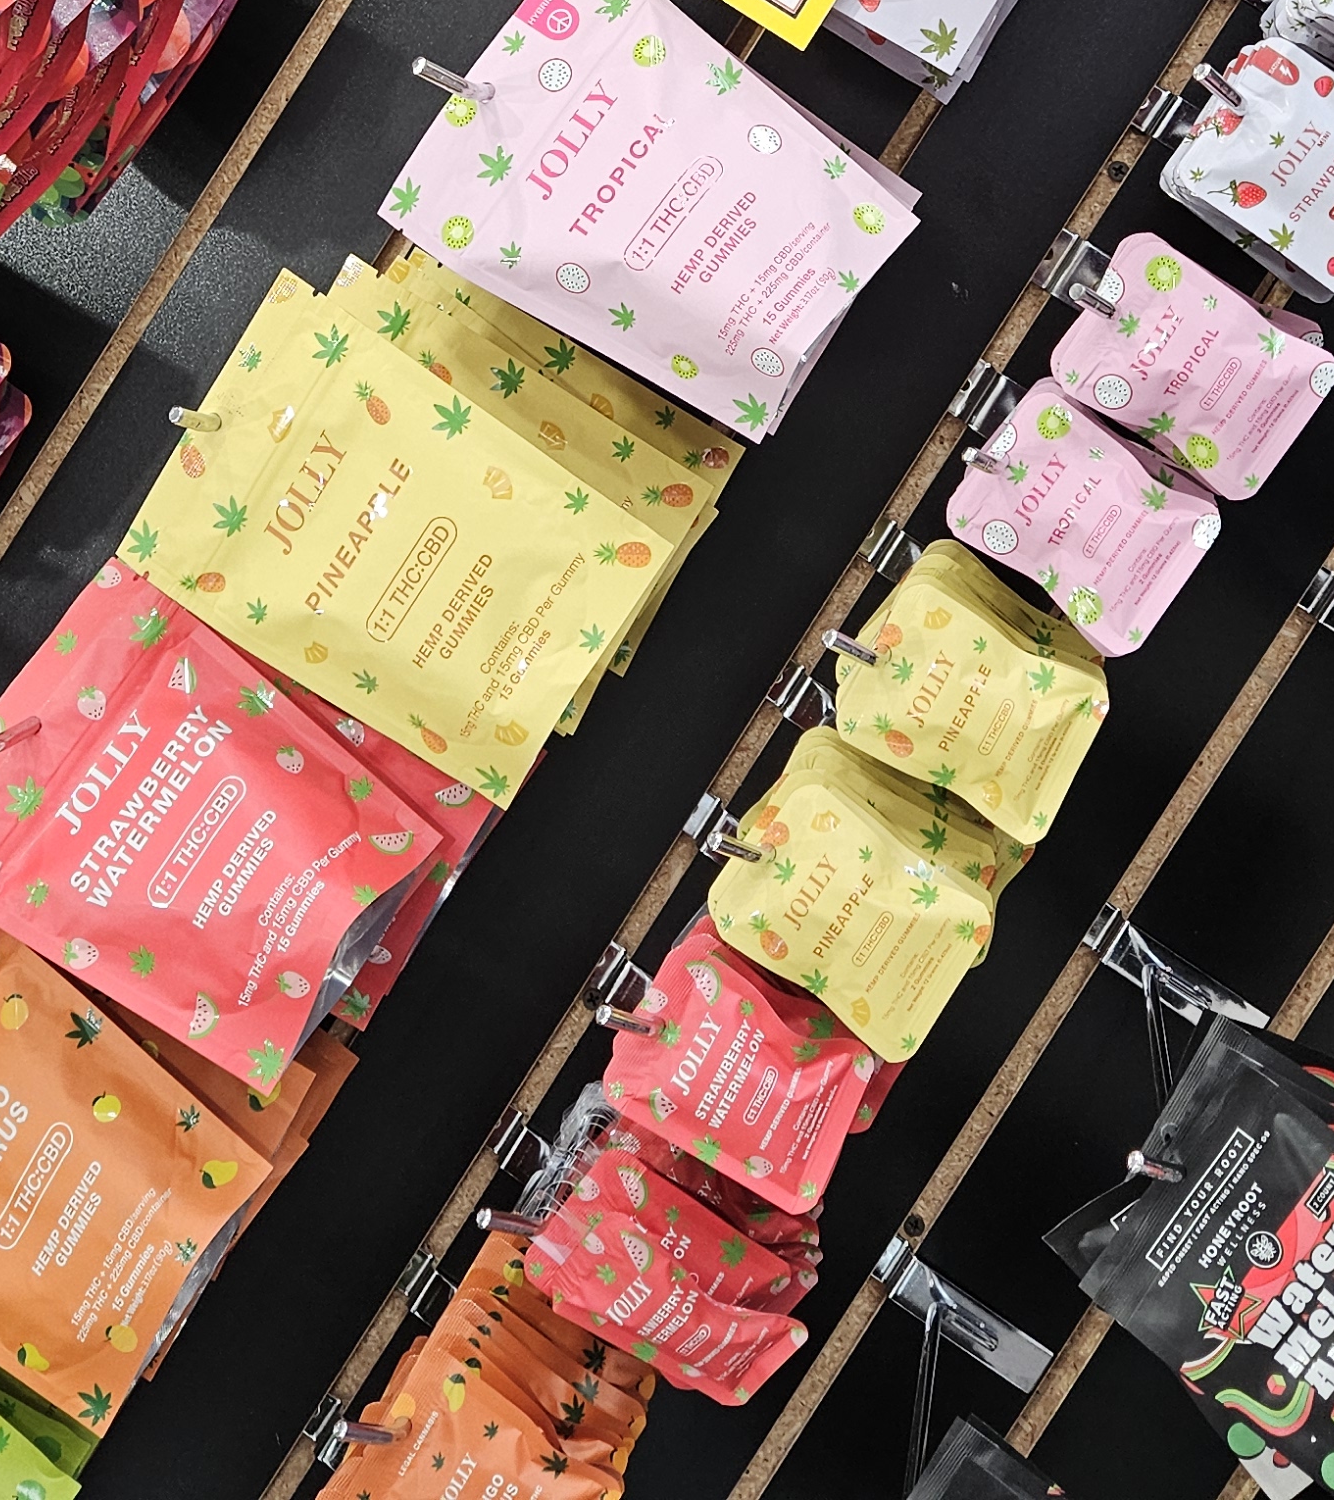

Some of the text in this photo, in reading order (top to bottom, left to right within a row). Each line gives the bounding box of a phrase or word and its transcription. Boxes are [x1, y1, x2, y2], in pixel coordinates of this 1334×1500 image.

[522, 76, 623, 201] JOLLY
[630, 158, 719, 264] 1:1 THC:CBD
[258, 429, 352, 556] JOLLY
[303, 456, 413, 616] PINEAPPLE
[1011, 450, 1070, 526] JOLLY
[1047, 472, 1102, 548] TROPICAL
[372, 522, 453, 635] 1:1 THC:CBD
[411, 551, 494, 669] HEMP DERIVED
[437, 582, 496, 661] GUMMIES
[51, 708, 155, 835] JOLLY
[67, 704, 212, 894] STRAWBERRY
[86, 717, 233, 911] WATERMELON
[152, 780, 241, 899] 1:1 THC:CBD
[812, 872, 876, 959] PINEAPPLE
[692, 1019, 756, 1121] STRAWBERRY
[706, 1028, 768, 1130] WATERMELON
